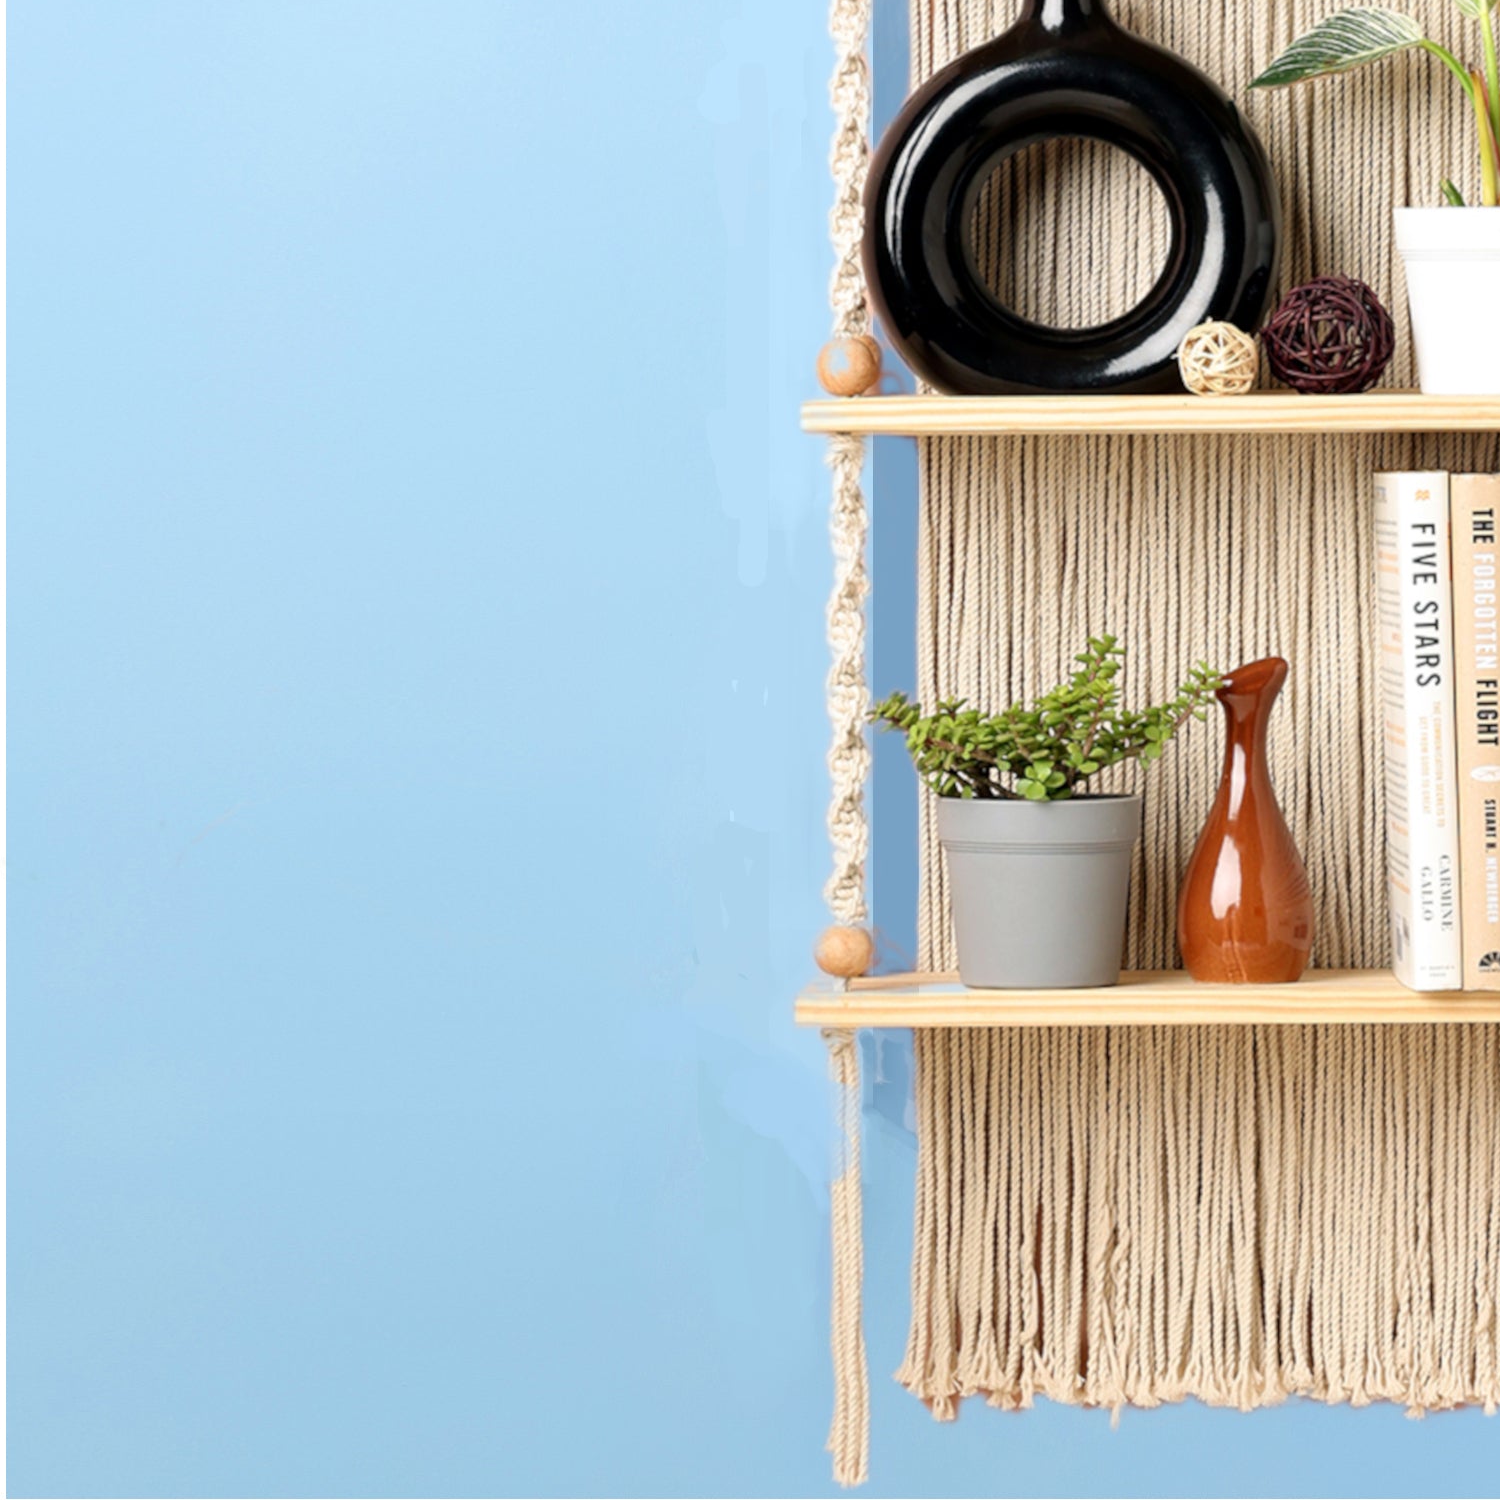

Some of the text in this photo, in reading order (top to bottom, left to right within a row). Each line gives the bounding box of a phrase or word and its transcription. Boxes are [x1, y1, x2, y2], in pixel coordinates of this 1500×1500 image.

[1411, 523, 1442, 687] FIVE STARS
[1472, 508, 1499, 746] THE FORGOTTEN FLIGHT
[1484, 799, 1497, 838] STUART
[1421, 866, 1435, 922] GALLO
[1438, 854, 1454, 932] CARMINE
